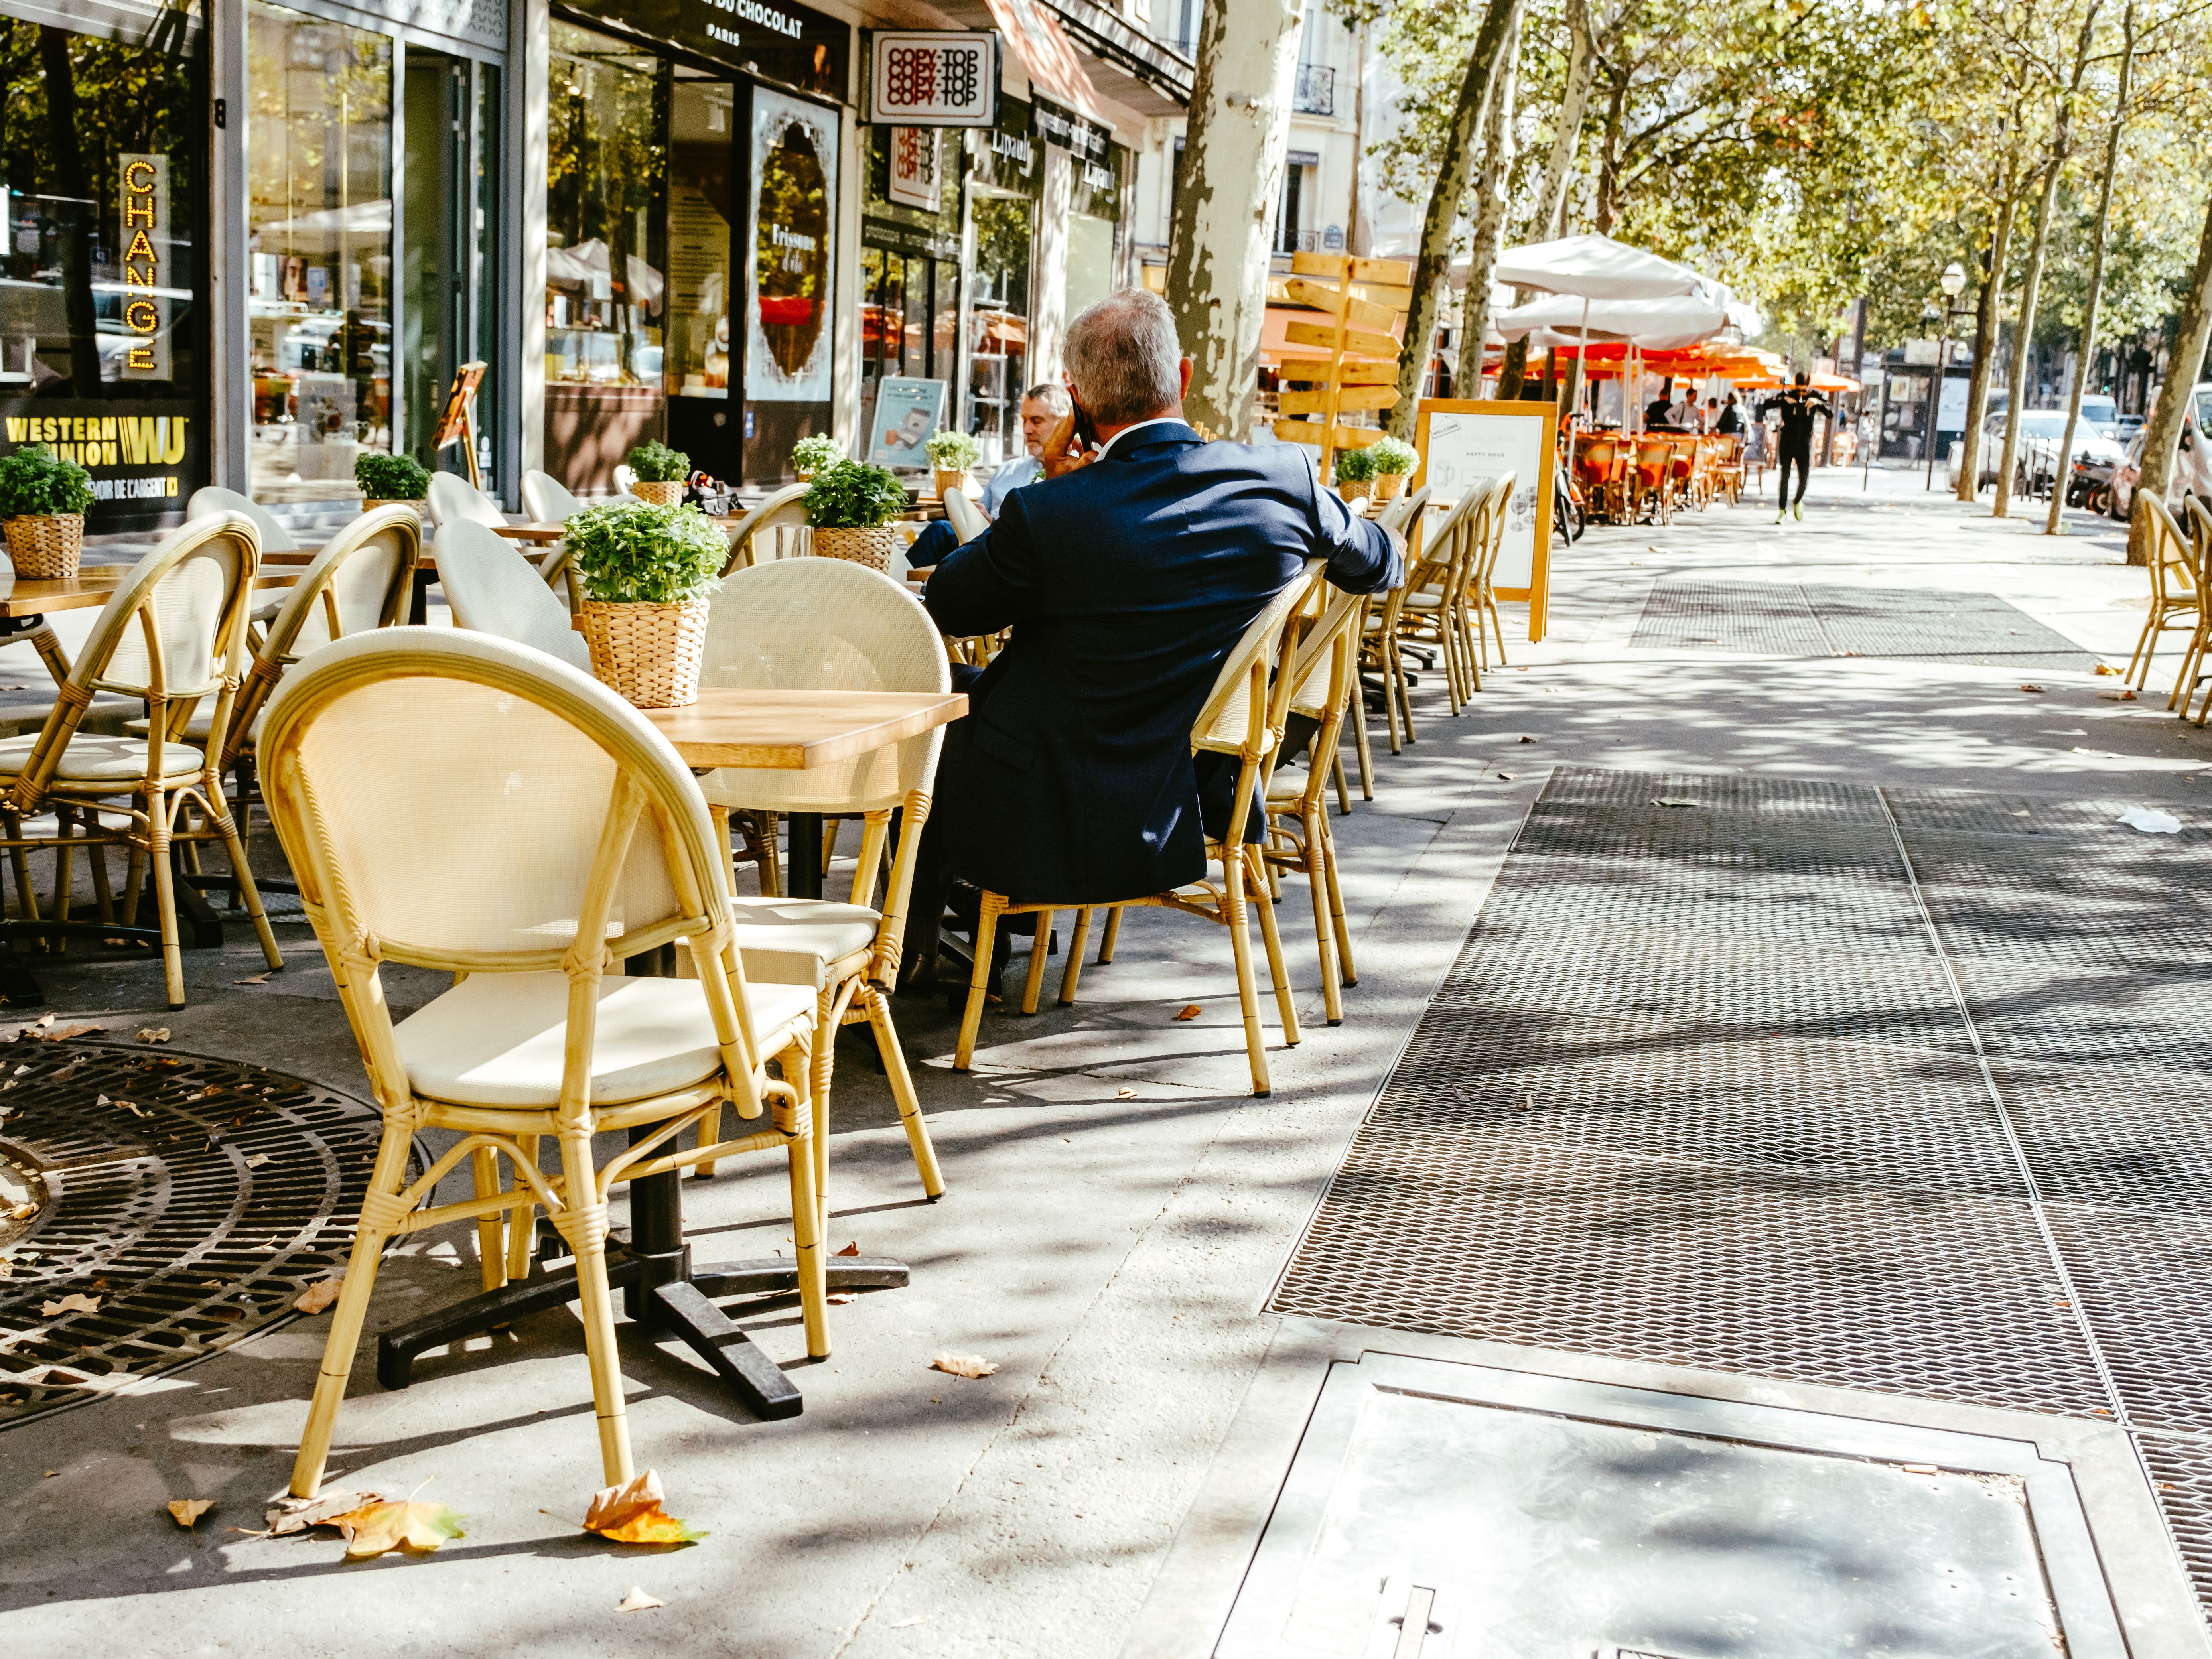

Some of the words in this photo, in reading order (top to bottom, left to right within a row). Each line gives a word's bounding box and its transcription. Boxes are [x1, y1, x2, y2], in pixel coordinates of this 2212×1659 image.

[735, 0, 803, 39] CHOCOLAT
[706, 23, 740, 47] PARIS
[889, 48, 978, 65] COPY-TOP
[888, 62, 977, 79] COPY-TOP
[888, 76, 977, 93] COPY-TOP
[887, 90, 976, 106] COPY-TOP
[125, 161, 157, 369] CHANGE
[6, 416, 117, 443] WESTERN
[1433, 423, 1459, 435] WELCOME
[114, 479, 127, 499] DE
